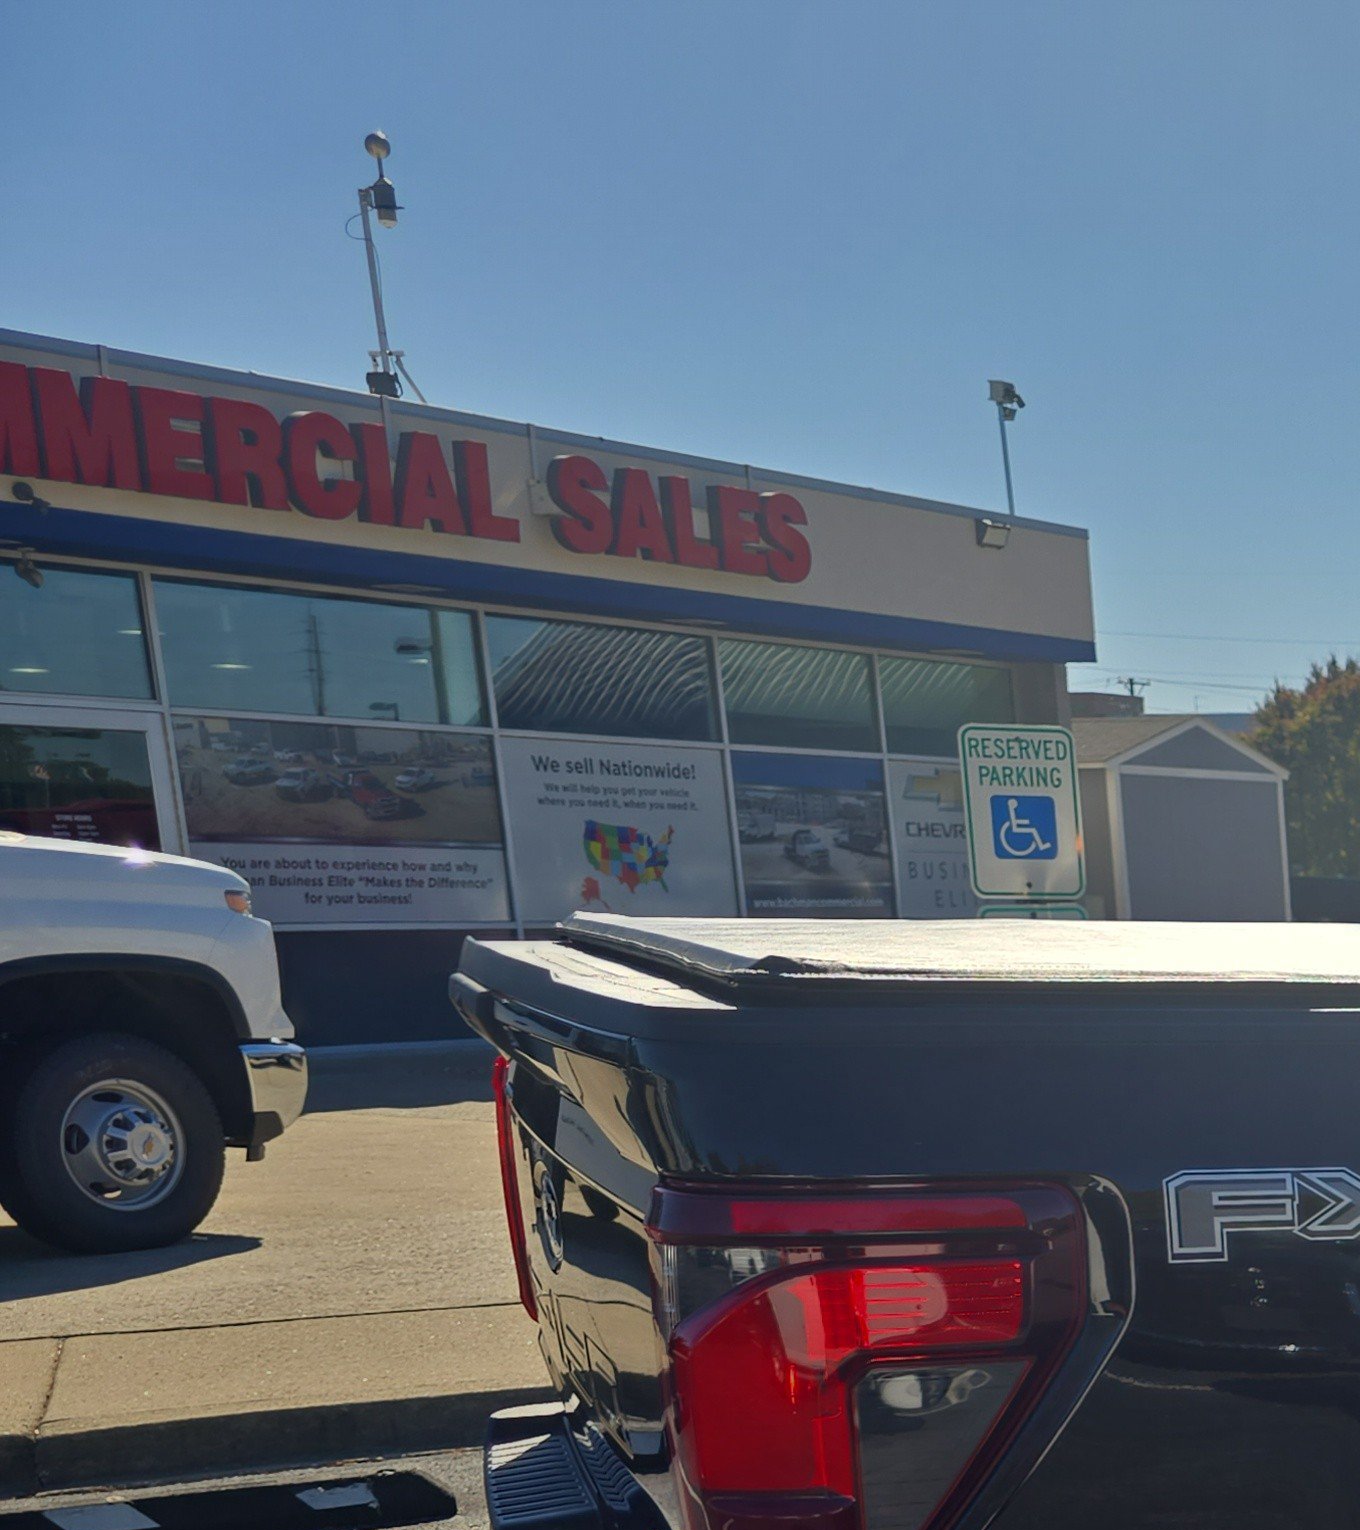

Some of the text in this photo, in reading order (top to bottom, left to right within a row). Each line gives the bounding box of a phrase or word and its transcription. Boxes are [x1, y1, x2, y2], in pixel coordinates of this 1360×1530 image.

[547, 454, 812, 583] SALES
[967, 737, 1067, 761] RESERVED
[530, 755, 696, 780] We sell Nationwide!
[979, 765, 1062, 788] PARKING
[580, 784, 599, 795] help
[602, 786, 619, 796] you
[905, 821, 967, 839] CHEVR
[220, 857, 478, 874] You are about to experience how and why
[908, 861, 969, 880] BUSIN
[269, 875, 323, 887] Business
[327, 875, 355, 887] Elite
[405, 877, 425, 888] the
[304, 893, 413, 906] for your business!
[934, 889, 970, 908] ELI
